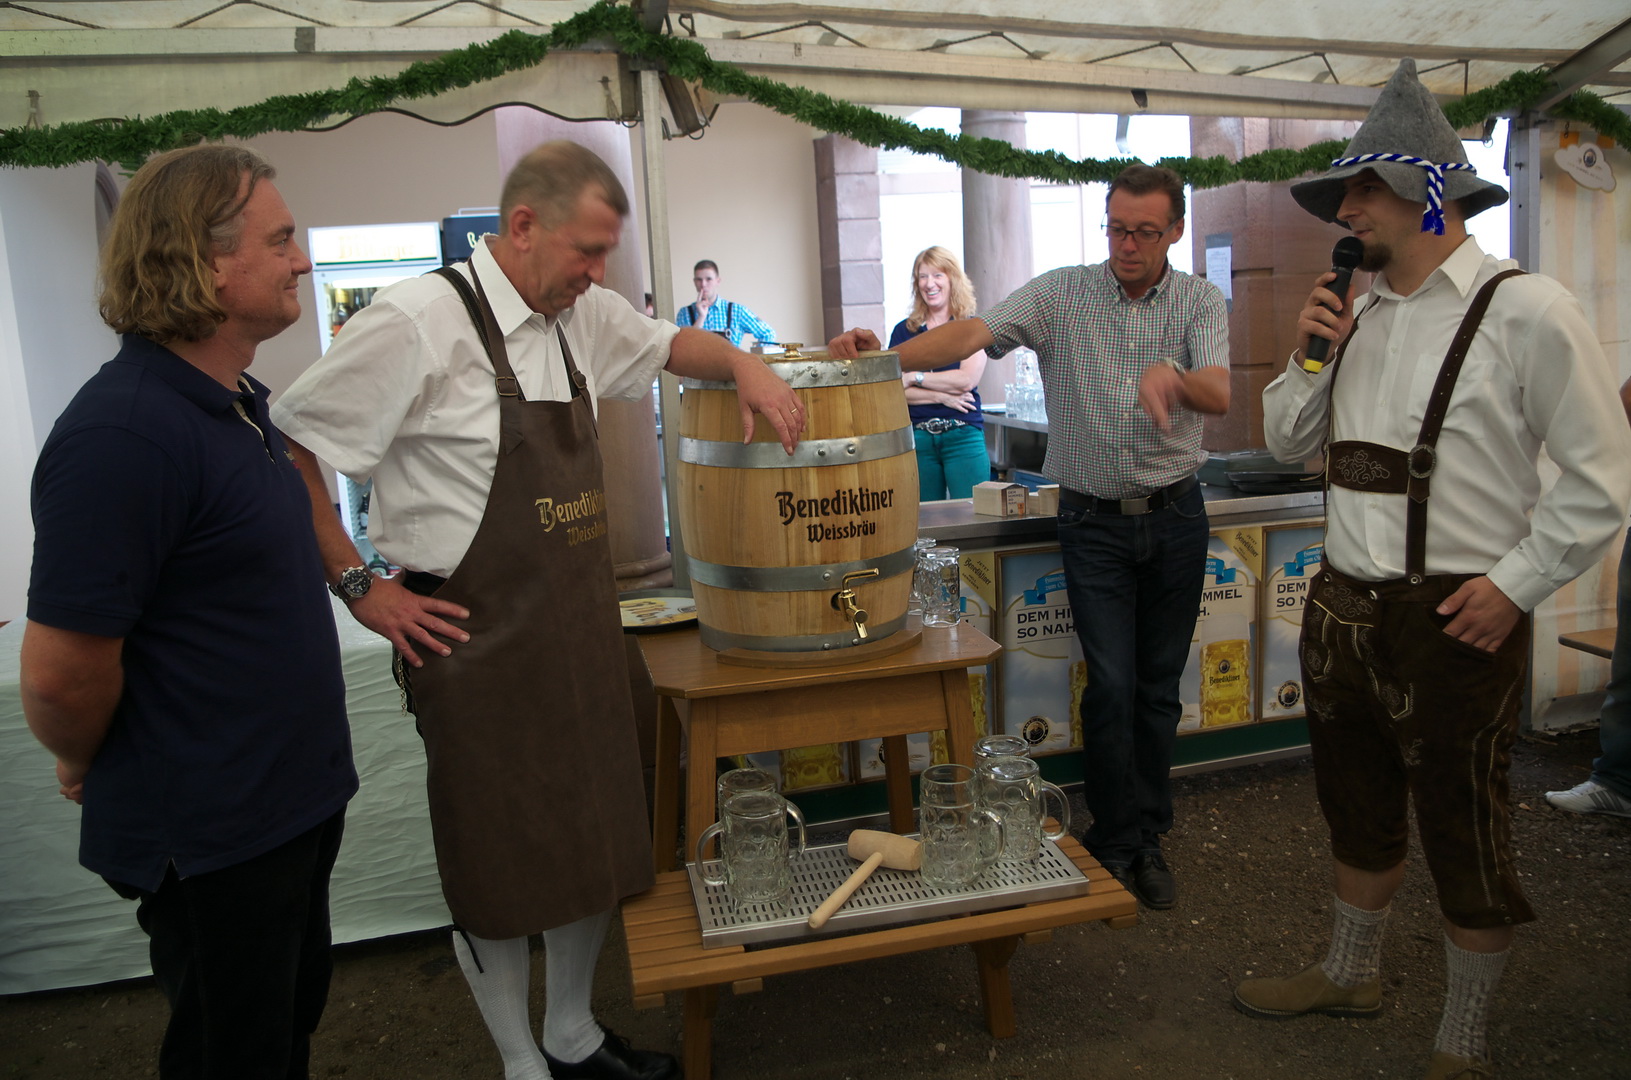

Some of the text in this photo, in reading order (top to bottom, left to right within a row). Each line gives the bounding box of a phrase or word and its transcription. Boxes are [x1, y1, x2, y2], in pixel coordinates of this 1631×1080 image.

[775, 487, 894, 526] Benediktiner
[806, 520, 876, 543] Weissbräu
[1277, 582, 1306, 594] DEM
[1276, 596, 1296, 608] SO
[1017, 610, 1049, 624] DEM
[1017, 622, 1076, 639] SO NAH
[1209, 674, 1240, 686] Benediktiner
